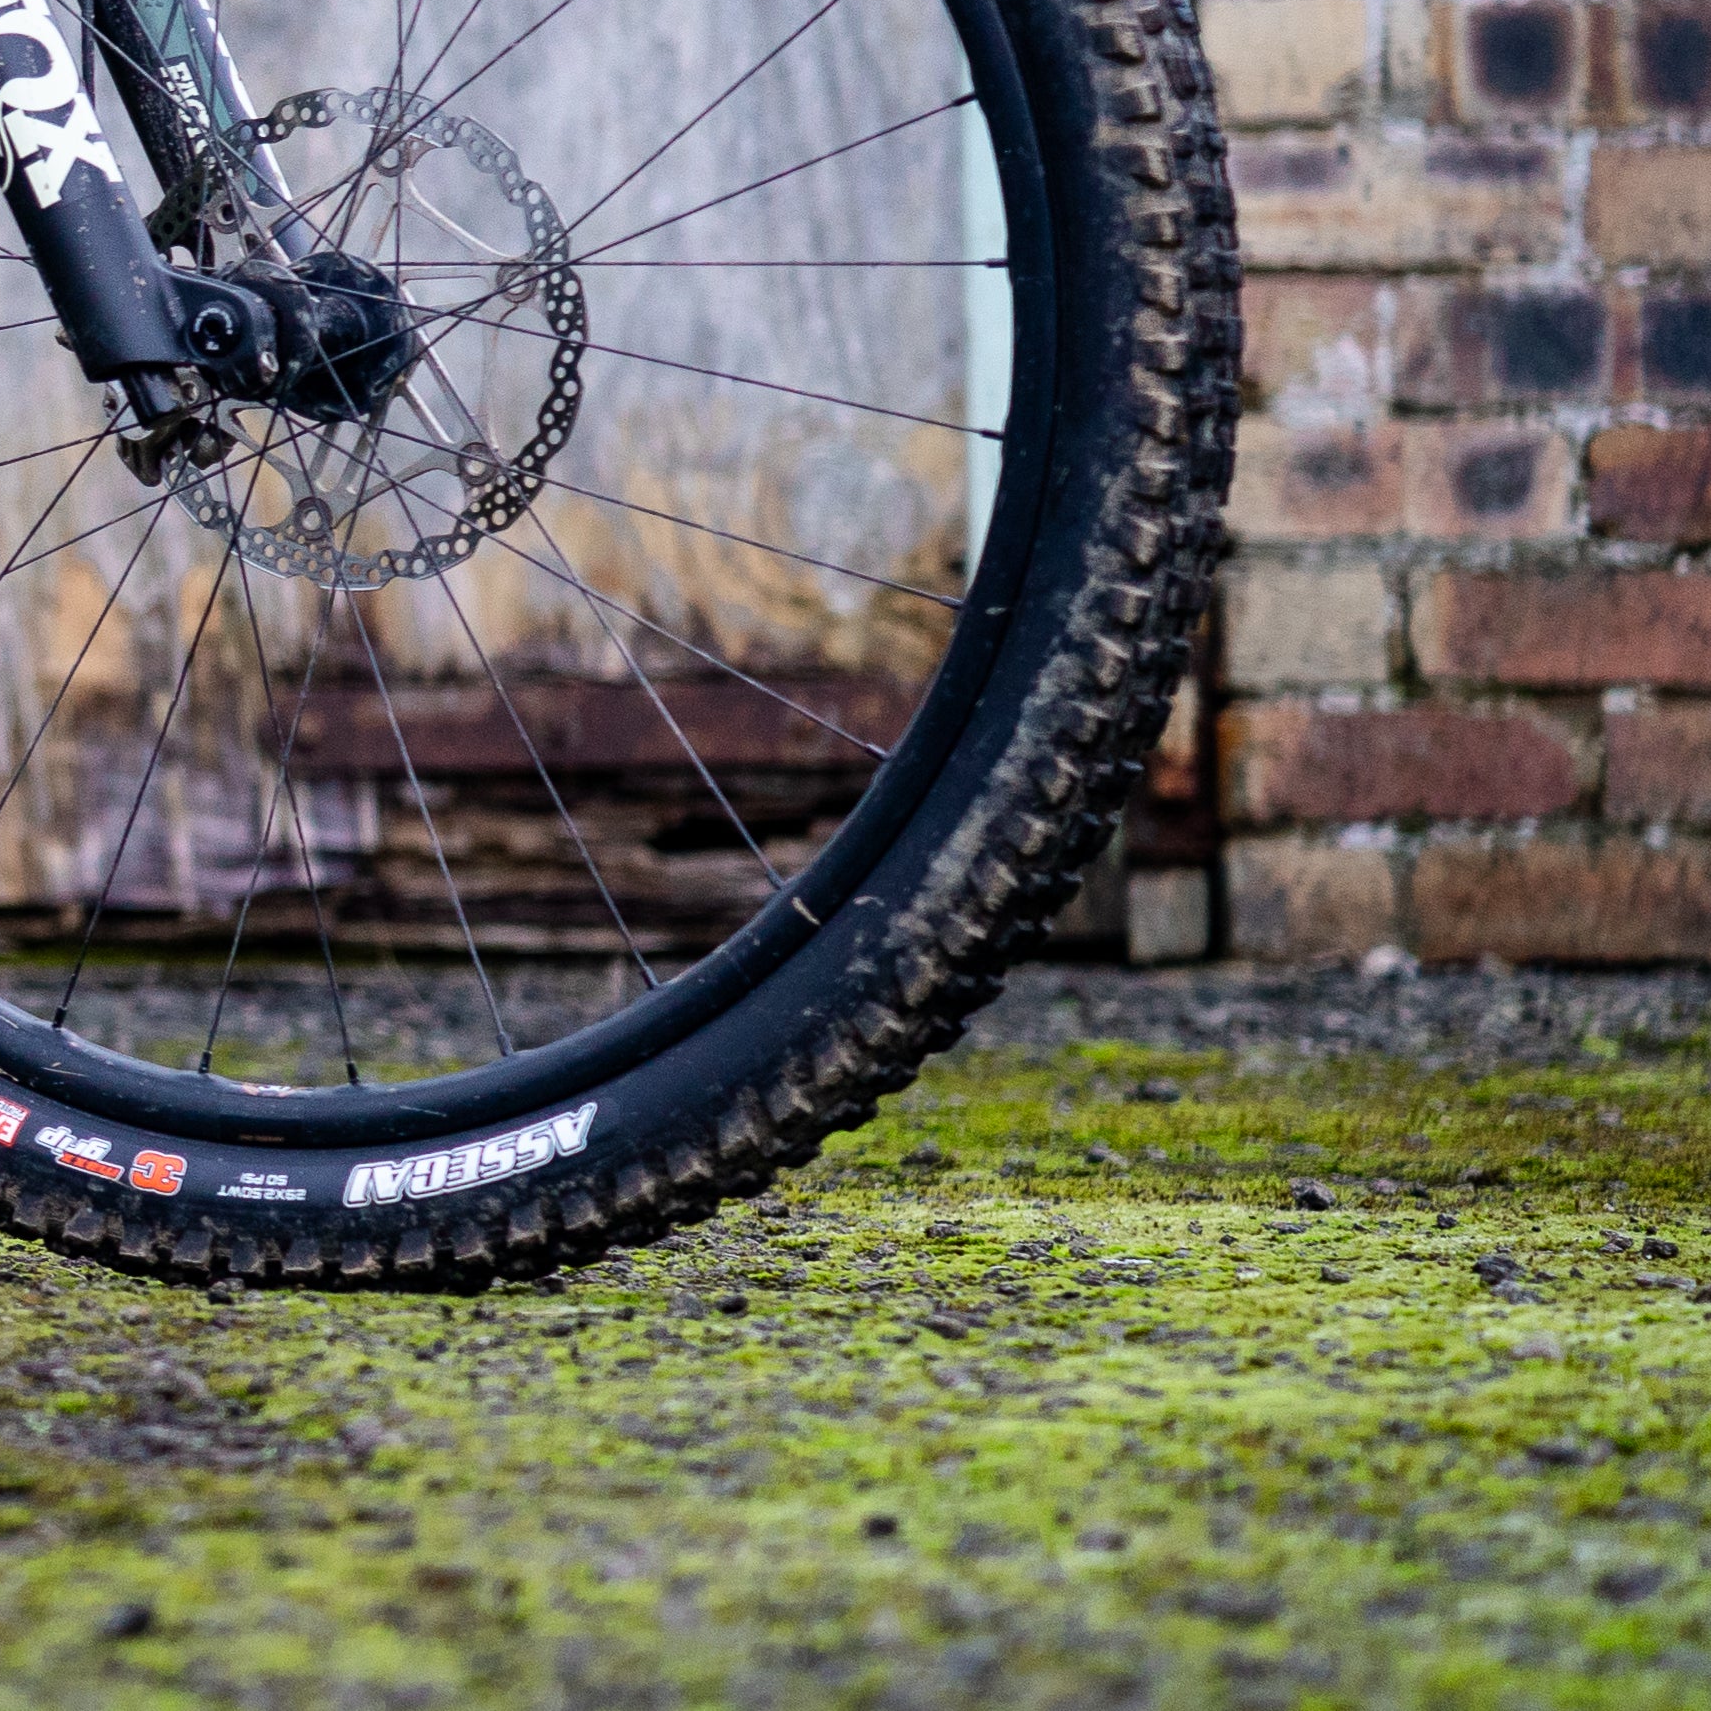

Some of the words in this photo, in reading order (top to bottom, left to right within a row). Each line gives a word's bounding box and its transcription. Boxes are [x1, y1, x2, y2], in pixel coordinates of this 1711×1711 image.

[34, 1125, 113, 1161] grip
[342, 1101, 598, 1209] ASSEGAI
[128, 1149, 188, 1197] 3C
[239, 1172, 265, 1185] PSI
[265, 1174, 288, 1186] 50
